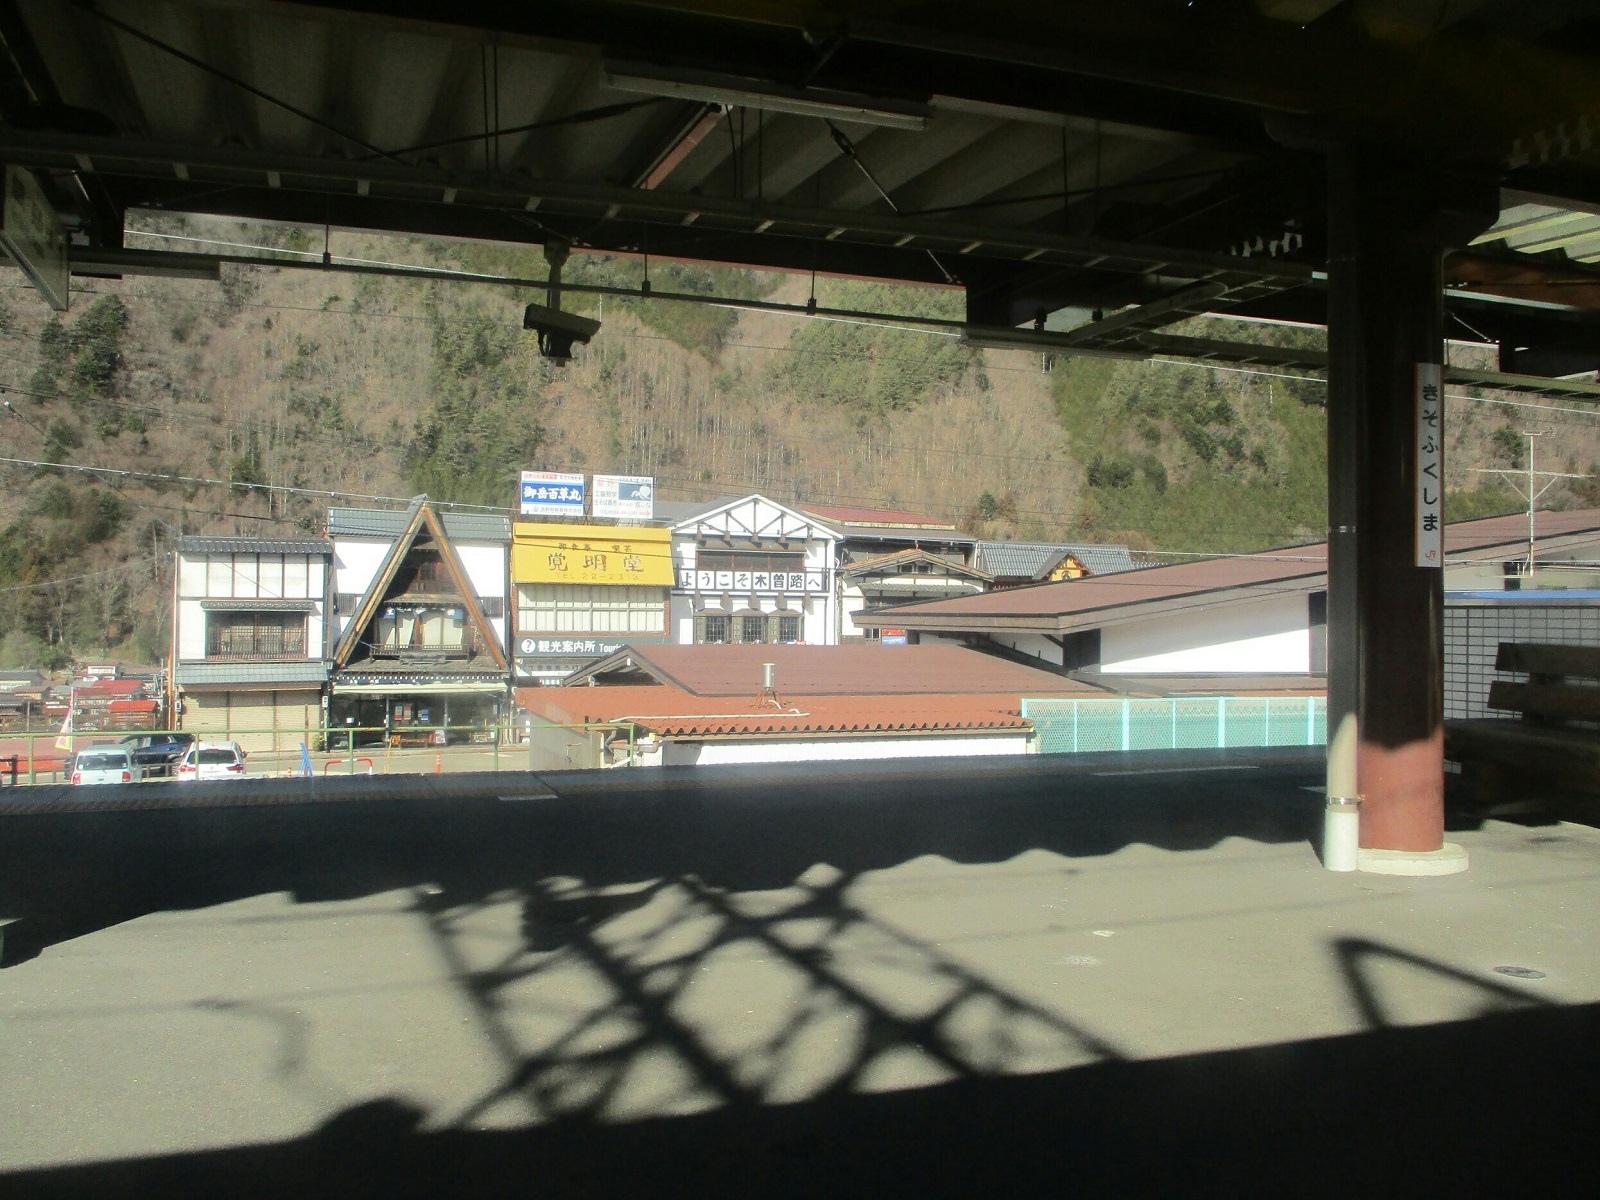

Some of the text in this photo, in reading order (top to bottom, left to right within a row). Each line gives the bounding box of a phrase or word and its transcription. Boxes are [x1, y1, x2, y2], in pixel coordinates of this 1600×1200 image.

[1421, 383, 1438, 532] きそふくしま
[523, 485, 582, 502] 御岳百草丸
[548, 552, 644, 573] 覚明堂
[555, 572, 577, 580] TEL
[681, 571, 821, 589] ようこそ木曽路へ
[538, 640, 596, 653] 観光案内所
